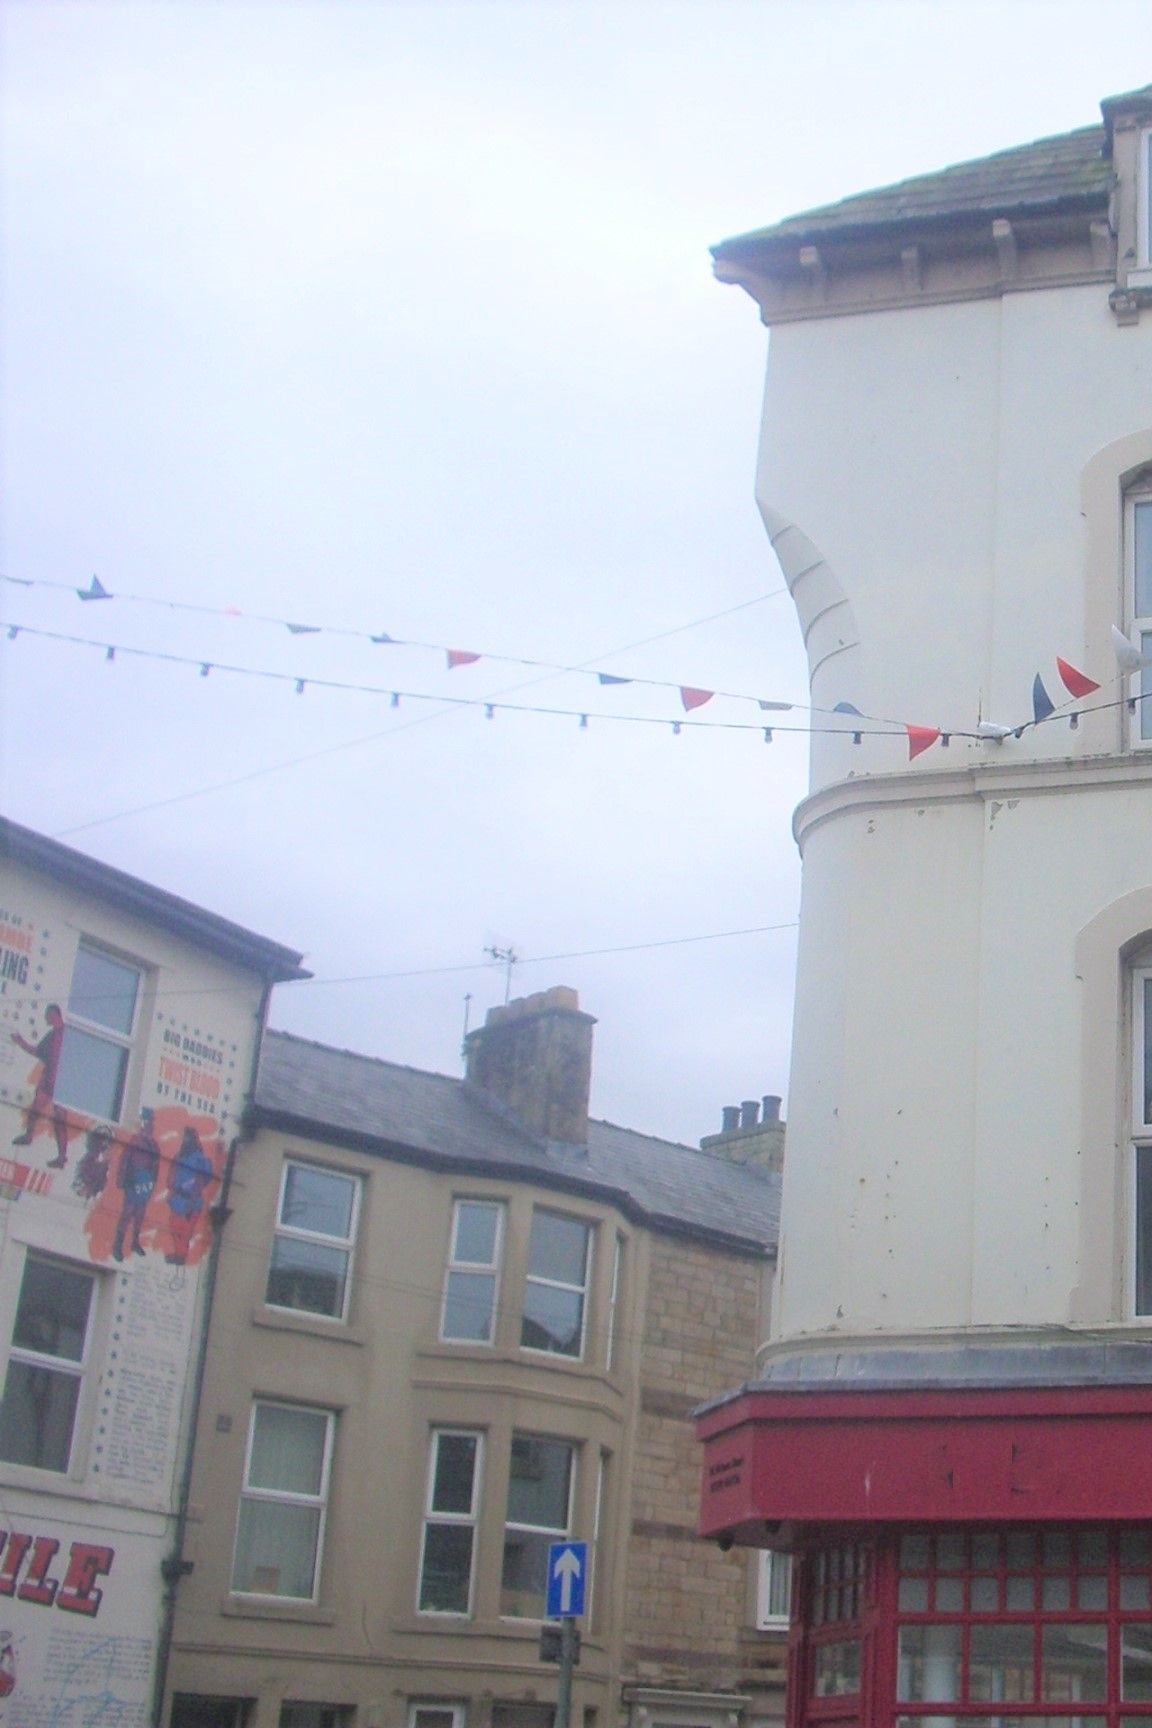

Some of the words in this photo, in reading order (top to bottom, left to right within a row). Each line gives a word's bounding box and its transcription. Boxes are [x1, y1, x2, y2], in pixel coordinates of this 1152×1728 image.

[163, 1028, 181, 1047] BIG
[174, 1088, 192, 1105] THE
[0, 1529, 115, 1618] ILE
